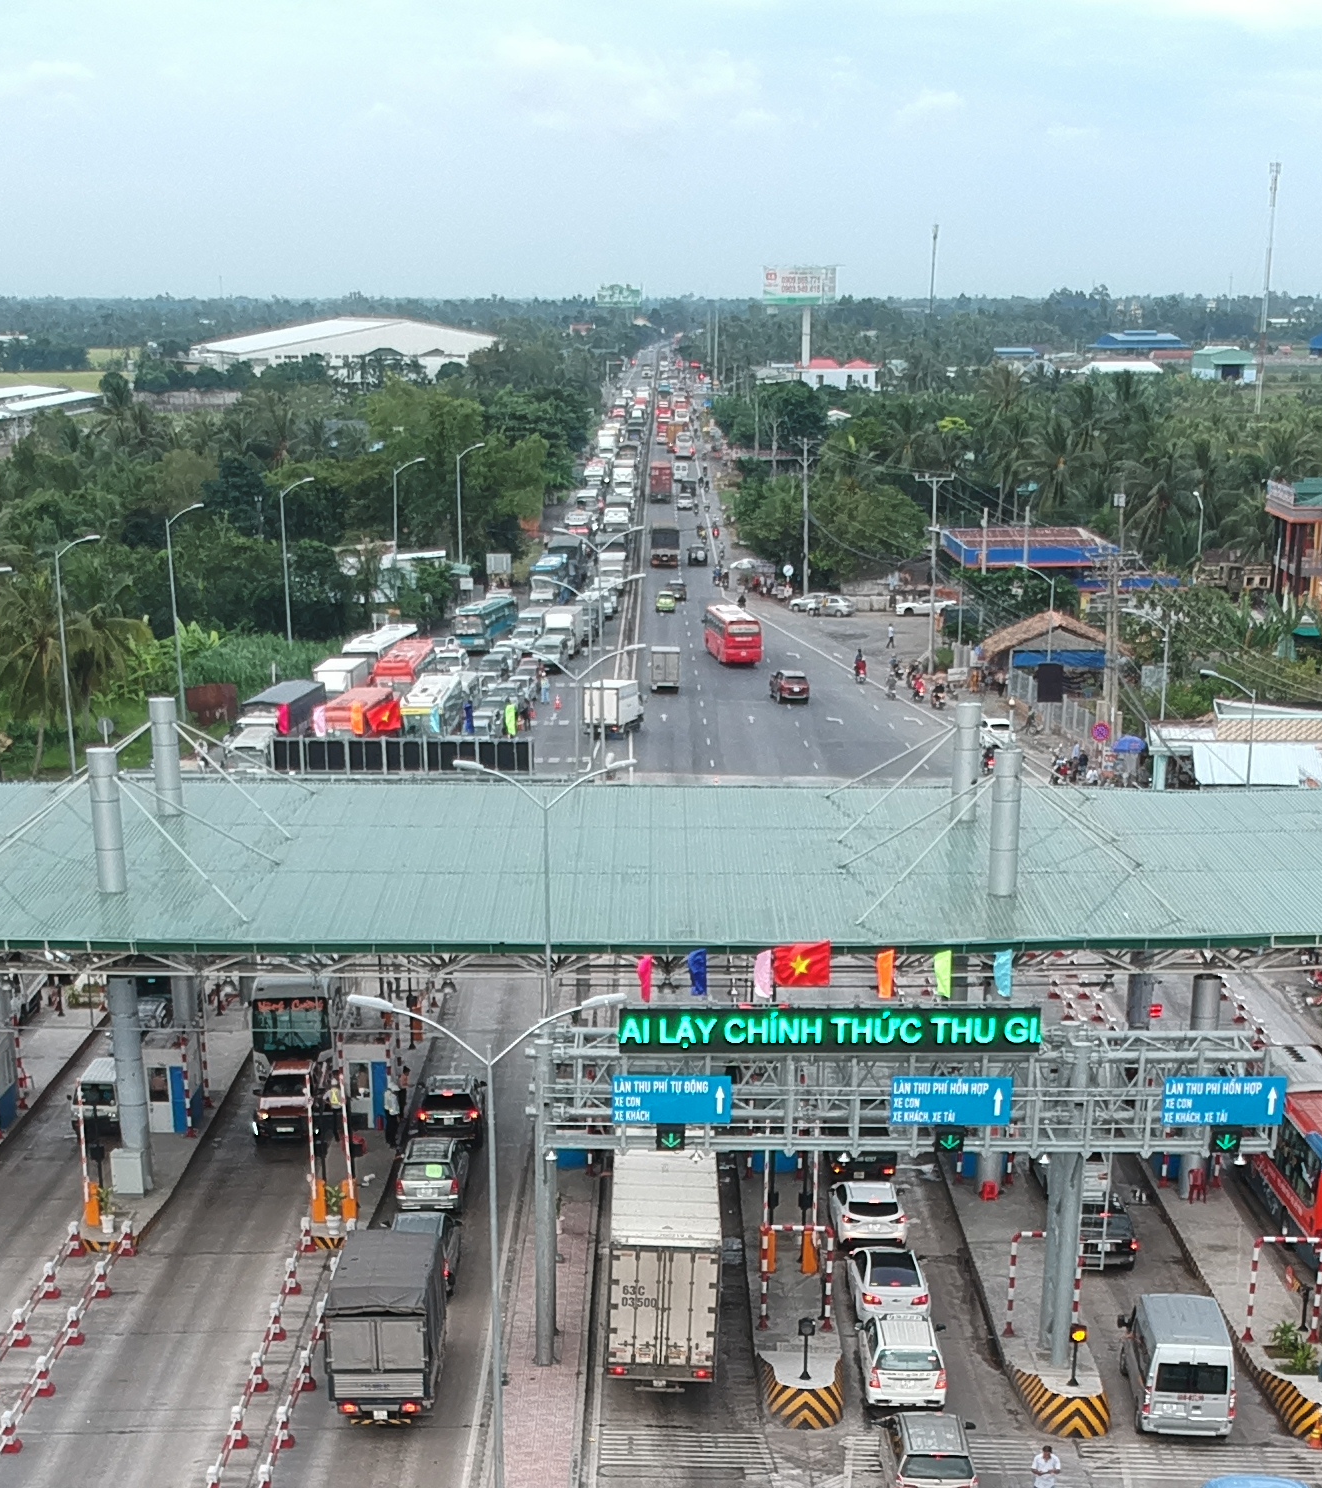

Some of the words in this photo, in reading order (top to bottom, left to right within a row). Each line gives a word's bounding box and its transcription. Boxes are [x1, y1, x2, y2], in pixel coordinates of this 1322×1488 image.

[619, 1017, 650, 1044] AI
[724, 1012, 822, 1045] CHÍNH
[831, 1011, 922, 1045] THỨC
[930, 1017, 996, 1044] THU
[1004, 1016, 1042, 1044] GI
[614, 1078, 631, 1093] LÀN
[634, 1081, 651, 1093] THU
[653, 1079, 668, 1093] PHÍ
[670, 1081, 683, 1096] TỰ
[684, 1079, 709, 1096] ĐỘNG
[893, 1080, 911, 1095] LÀN
[914, 1082, 930, 1095] THU
[932, 1080, 949, 1095] PHÍ
[971, 1082, 989, 1097] HỢP
[1165, 1080, 1184, 1095] LÀN
[1186, 1082, 1203, 1095] THU
[1205, 1080, 1222, 1095] PHÍ
[1244, 1082, 1263, 1096] HỢP
[614, 1096, 624, 1107] XE
[626, 1096, 641, 1107] CON
[893, 1098, 903, 1108] XE
[904, 1098, 920, 1108] CON
[1165, 1098, 1175, 1109] XE
[1176, 1098, 1193, 1109] CON
[614, 1110, 624, 1121] XE
[626, 1108, 650, 1121] KHÁCH
[892, 1111, 902, 1122] XE
[932, 1111, 942, 1122] XE
[943, 1109, 956, 1122] TẢI
[1164, 1112, 1174, 1123] XE
[1204, 1112, 1214, 1122] XE
[1216, 1109, 1228, 1123] TẢI
